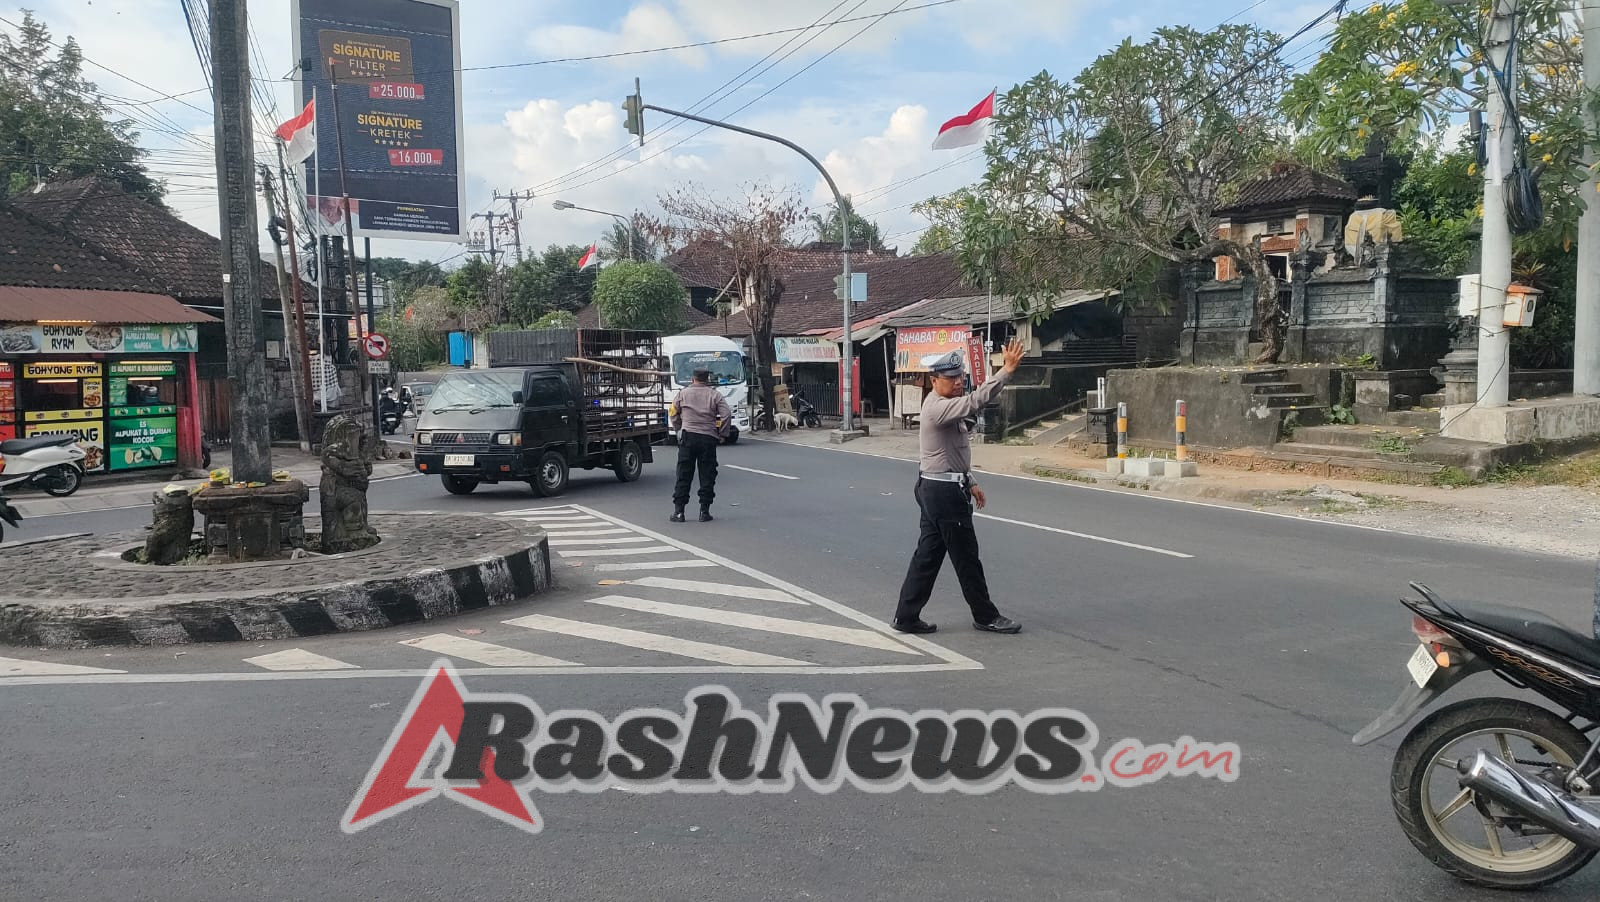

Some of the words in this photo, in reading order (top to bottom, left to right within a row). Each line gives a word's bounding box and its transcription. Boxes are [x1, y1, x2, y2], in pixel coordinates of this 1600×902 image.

[333, 43, 401, 62] SIGNATURE
[349, 58, 386, 72] FILTER
[381, 84, 415, 99] 25.000
[357, 113, 423, 130] SIGNATURE
[370, 128, 411, 140] KRETEK
[398, 151, 432, 164] 16.000
[43, 326, 83, 336] GOHYONG
[899, 329, 938, 345] SAHABAT
[969, 337, 982, 347] JOK
[28, 366, 73, 375] GOHYONG
[972, 346, 983, 383] SADEL
[139, 420, 147, 428] ES
[115, 428, 142, 438] ALPUKAT
[150, 427, 172, 436] DURIAN
[132, 436, 155, 444] KOCOK
